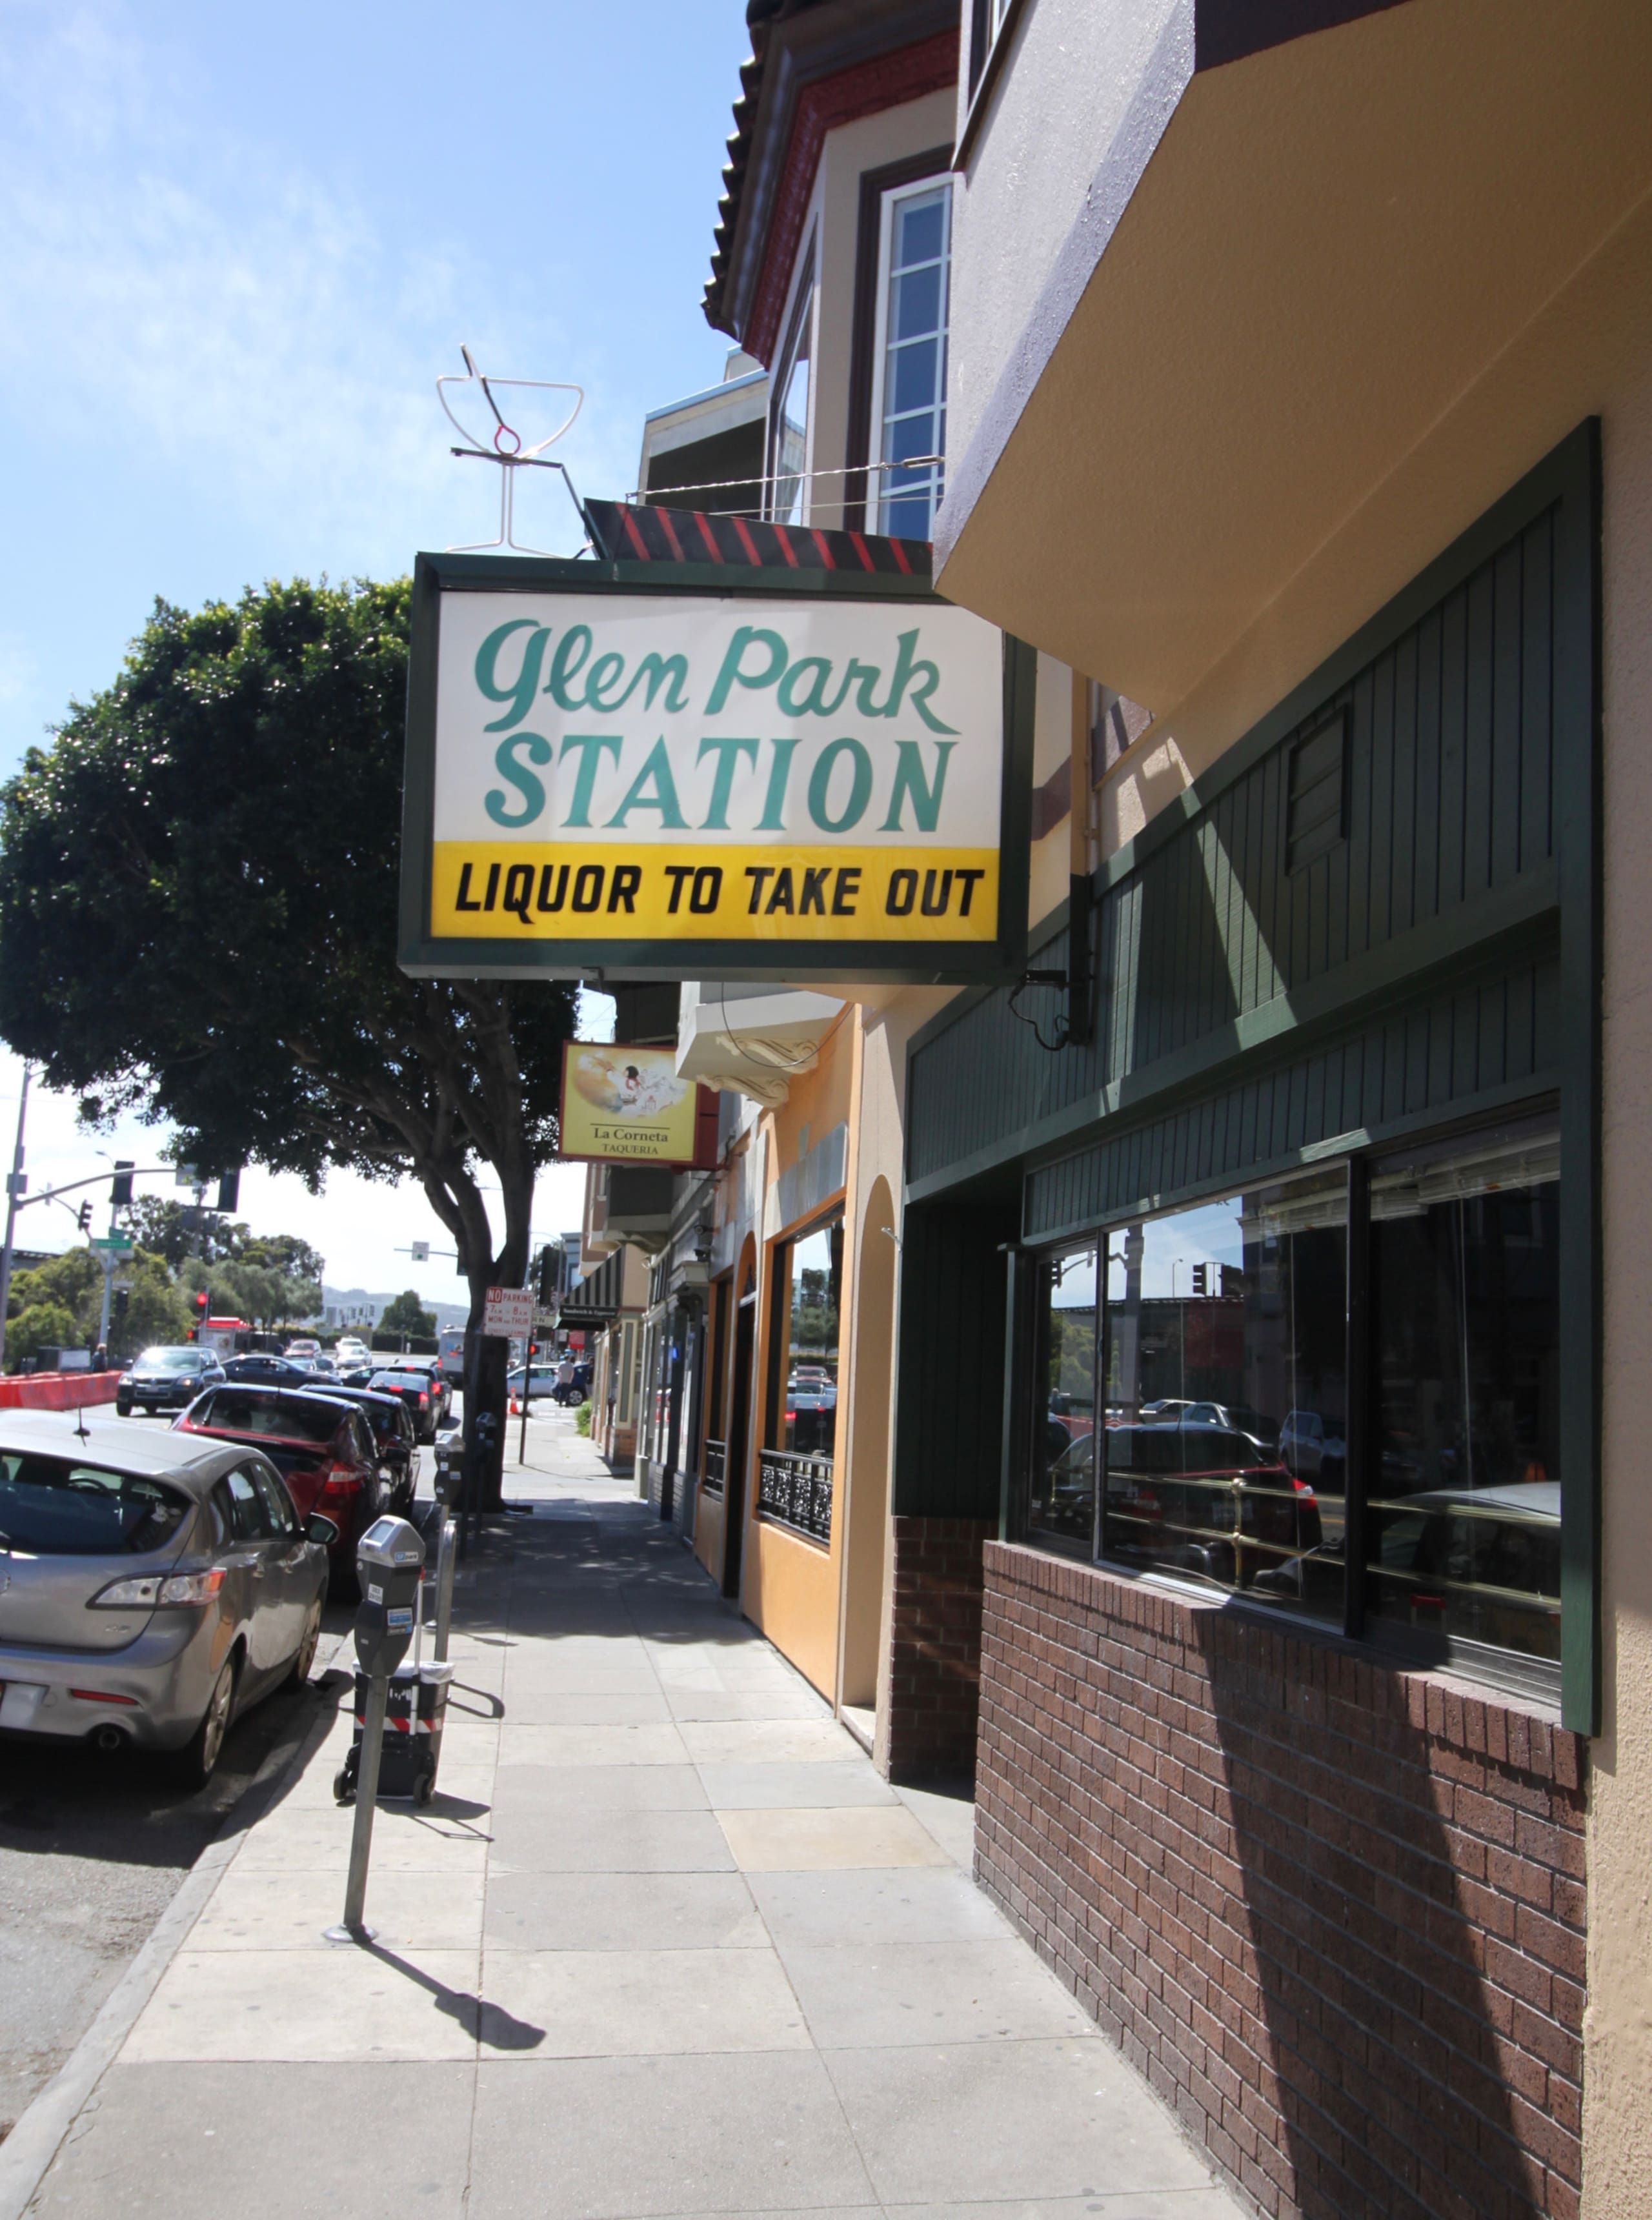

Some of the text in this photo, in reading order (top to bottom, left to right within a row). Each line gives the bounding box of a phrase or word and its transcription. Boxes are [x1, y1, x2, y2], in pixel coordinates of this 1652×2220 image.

[474, 618, 962, 736] Glen Park
[483, 732, 960, 833] STATION
[455, 862, 985, 924] LIQUOR TO TAKE OUT
[594, 1127, 668, 1142] La Corneta
[602, 1144, 658, 1155] TAQUERIA
[489, 1289, 532, 1304] NO PARKING
[512, 1317, 529, 1326] THUR
